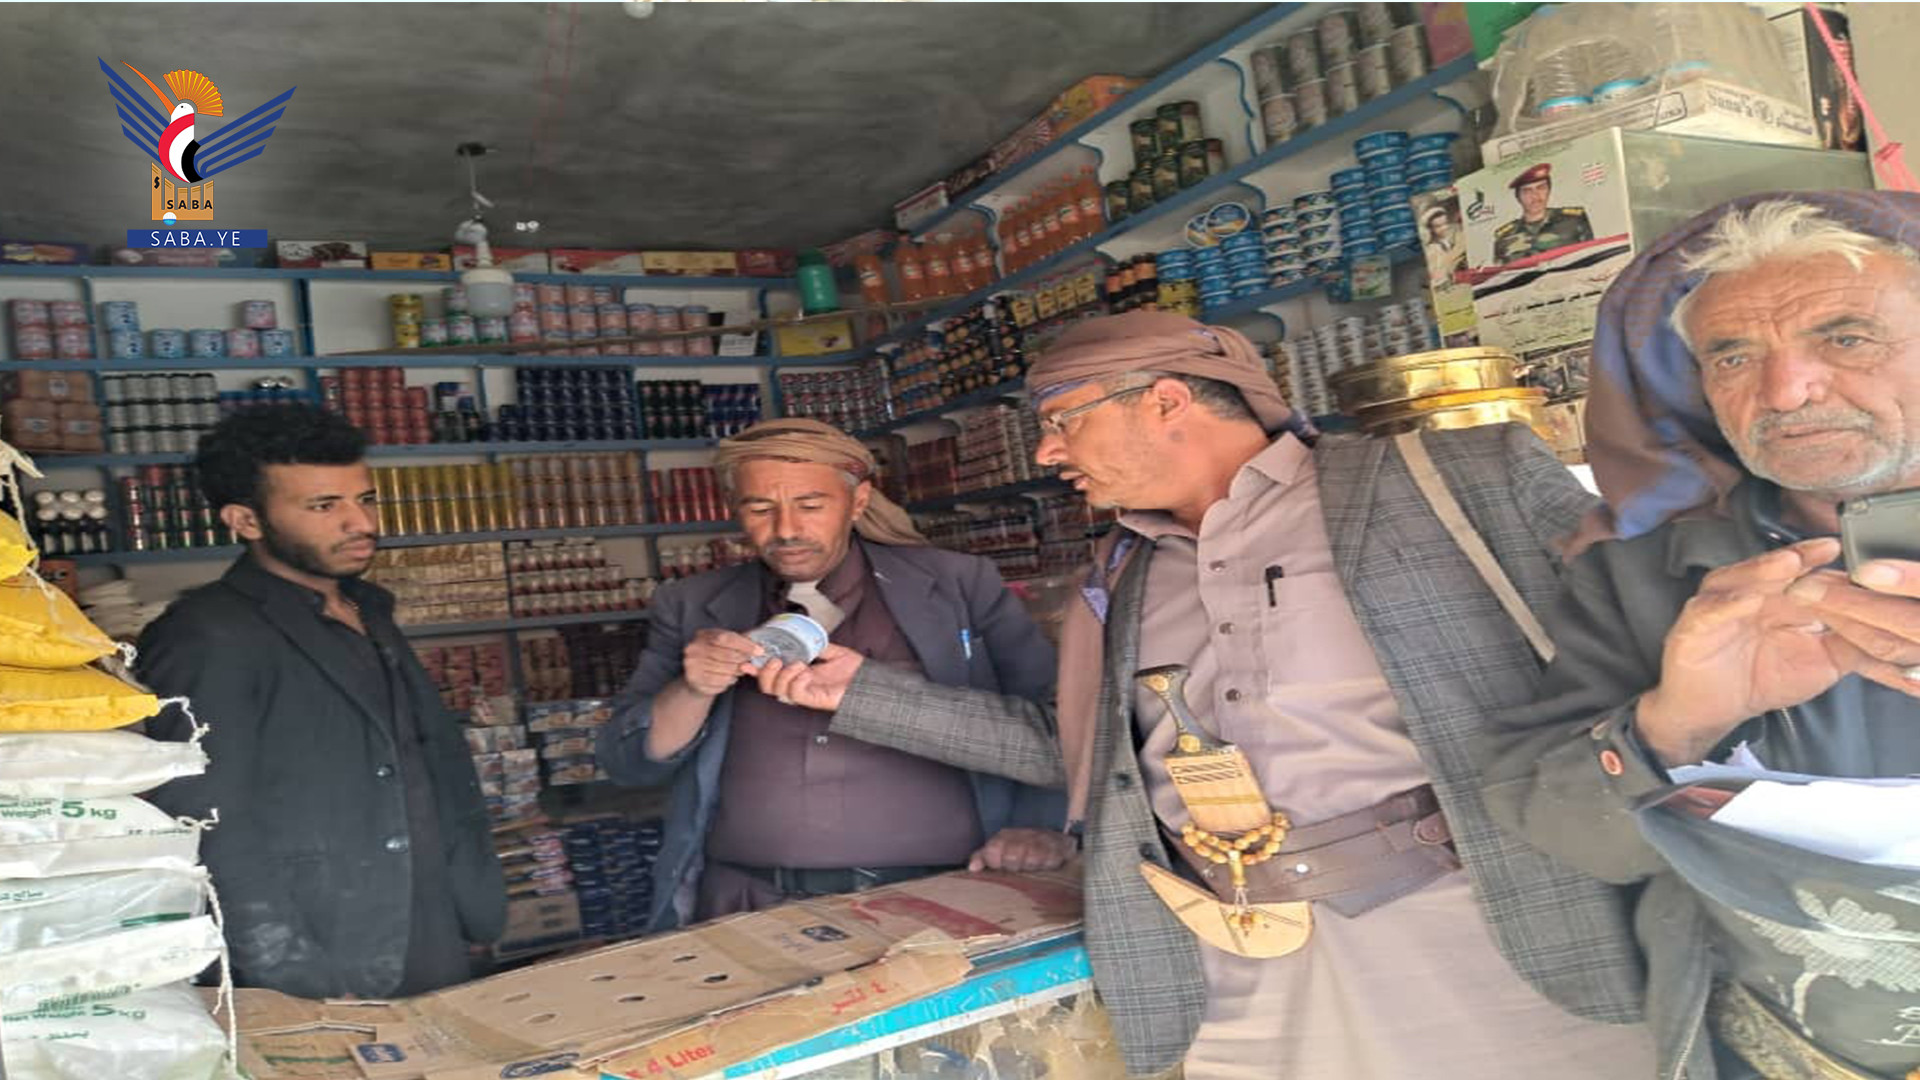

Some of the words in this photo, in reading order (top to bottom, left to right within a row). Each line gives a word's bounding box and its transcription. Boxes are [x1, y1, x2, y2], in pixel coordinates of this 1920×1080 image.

[61, 800, 86, 818] 5
[90, 807, 117, 820] kg
[91, 1003, 116, 1017] 5
[664, 1043, 716, 1069] Liter
